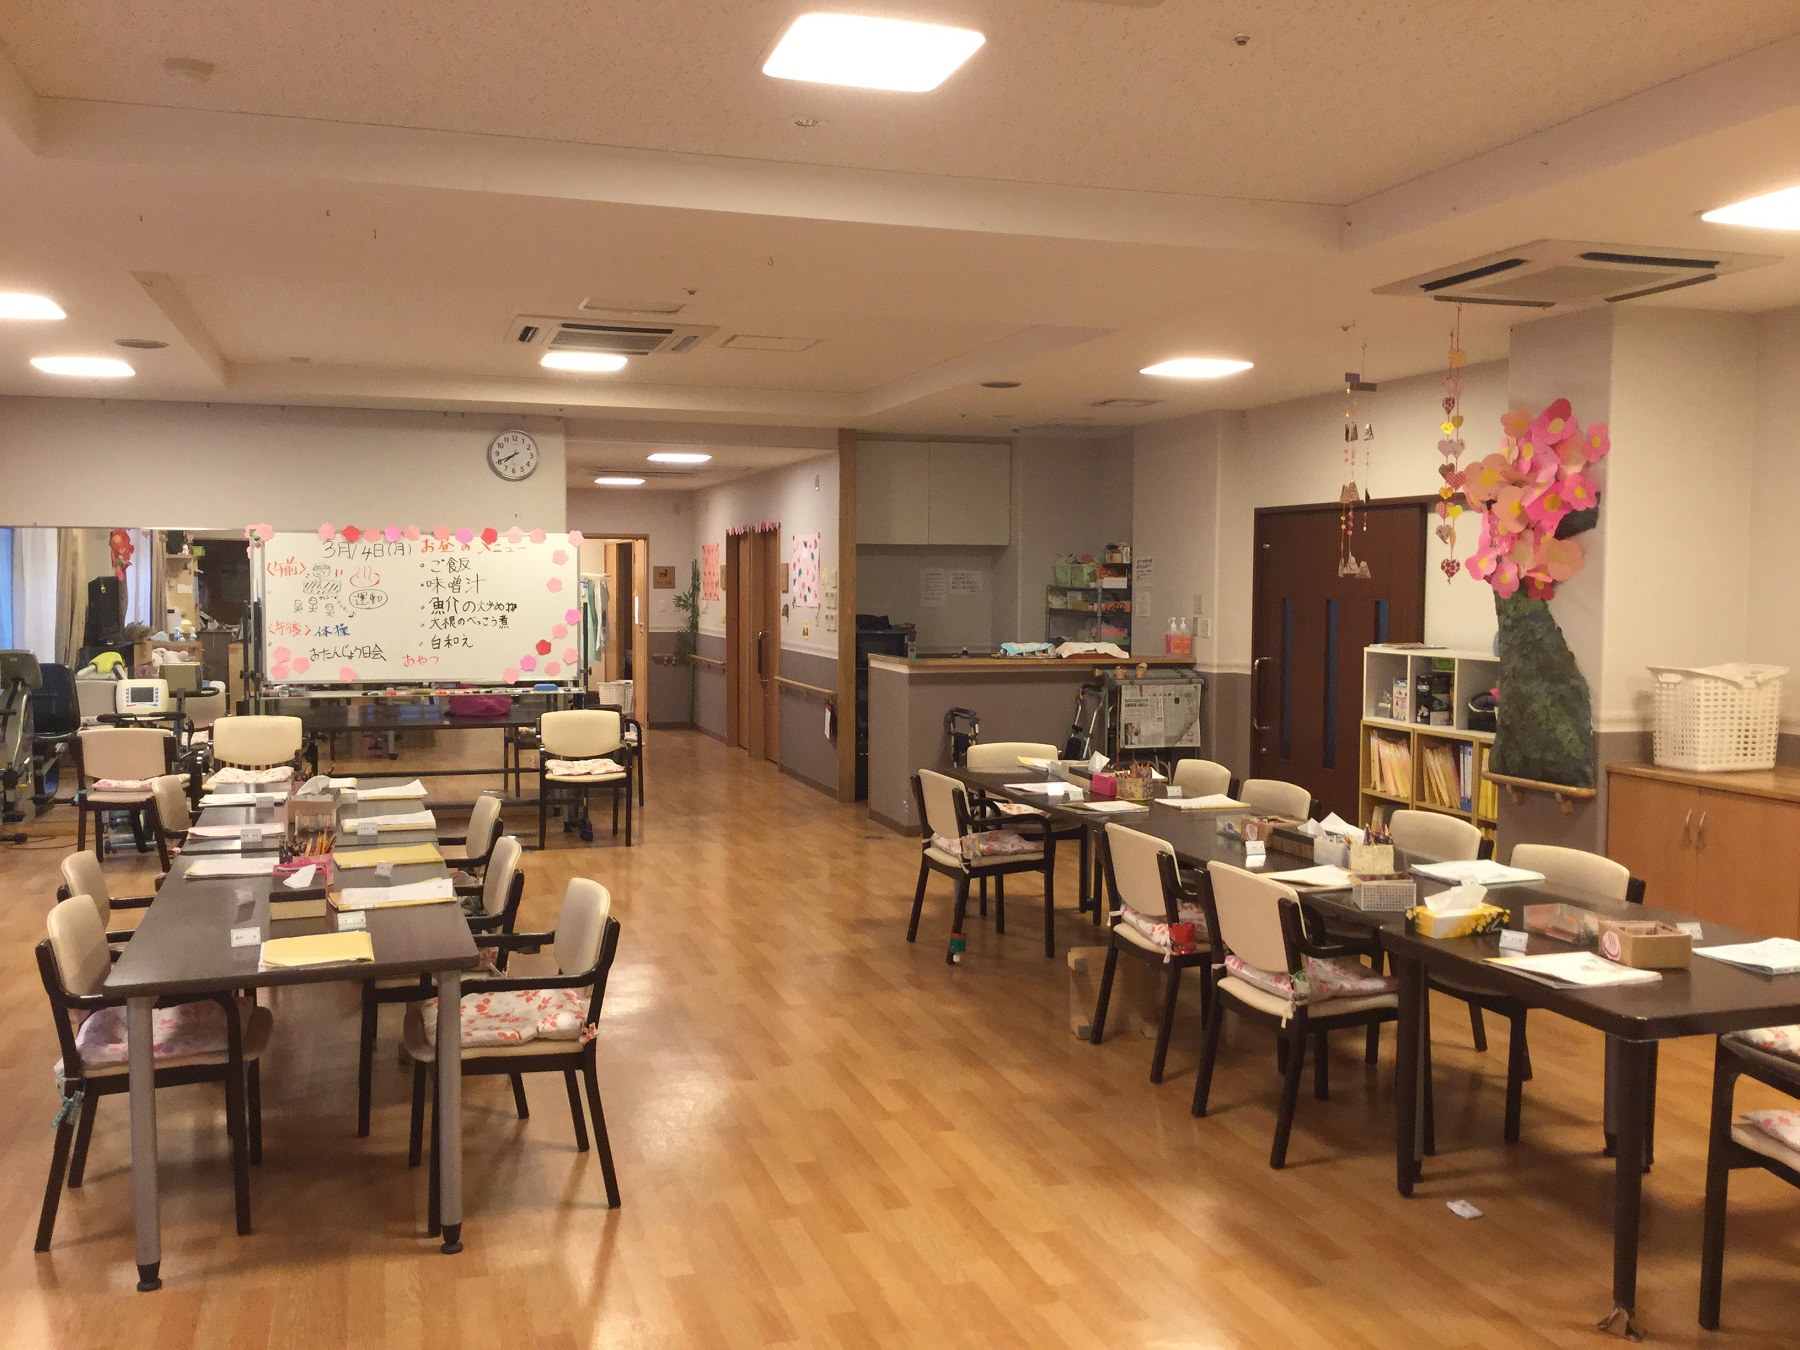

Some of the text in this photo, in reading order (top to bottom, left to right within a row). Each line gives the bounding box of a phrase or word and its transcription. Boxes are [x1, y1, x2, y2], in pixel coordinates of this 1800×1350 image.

[430, 556, 472, 573] ご飯
[426, 573, 487, 594] 味噌汁
[429, 614, 510, 630] 大根のべっこう煮
[309, 643, 387, 662] おたんじょう日会
[402, 653, 439, 668] おやつ
